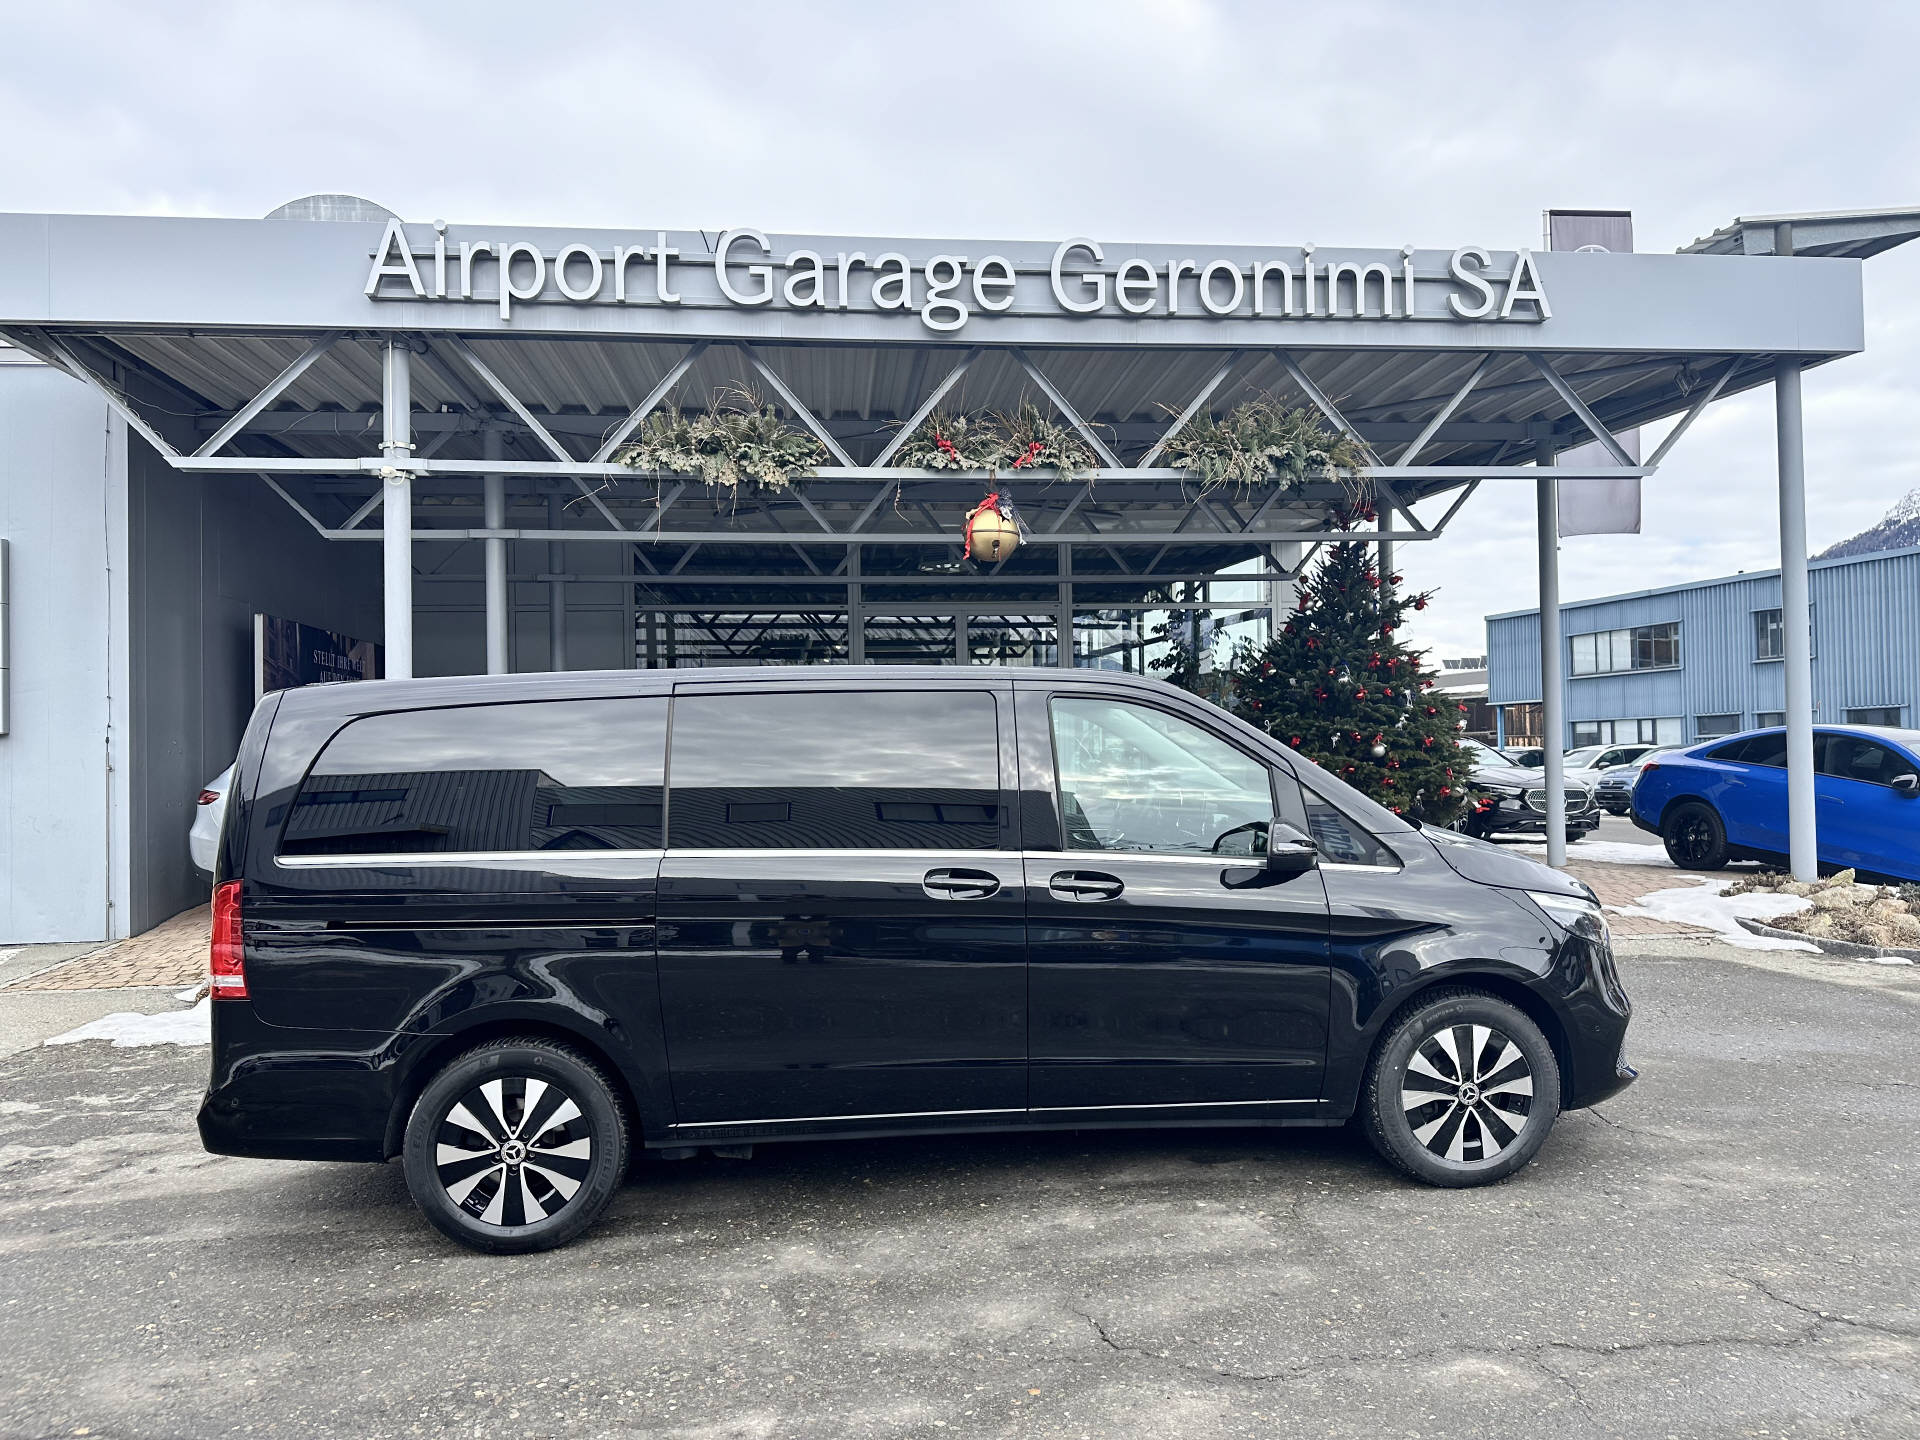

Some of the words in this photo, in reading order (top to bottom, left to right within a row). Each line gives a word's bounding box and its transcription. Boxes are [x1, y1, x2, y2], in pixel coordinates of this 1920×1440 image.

[364, 218, 681, 321] Airport
[714, 228, 1017, 332] Garage
[1050, 236, 1416, 318] Geronimi
[1447, 245, 1552, 320] SA
